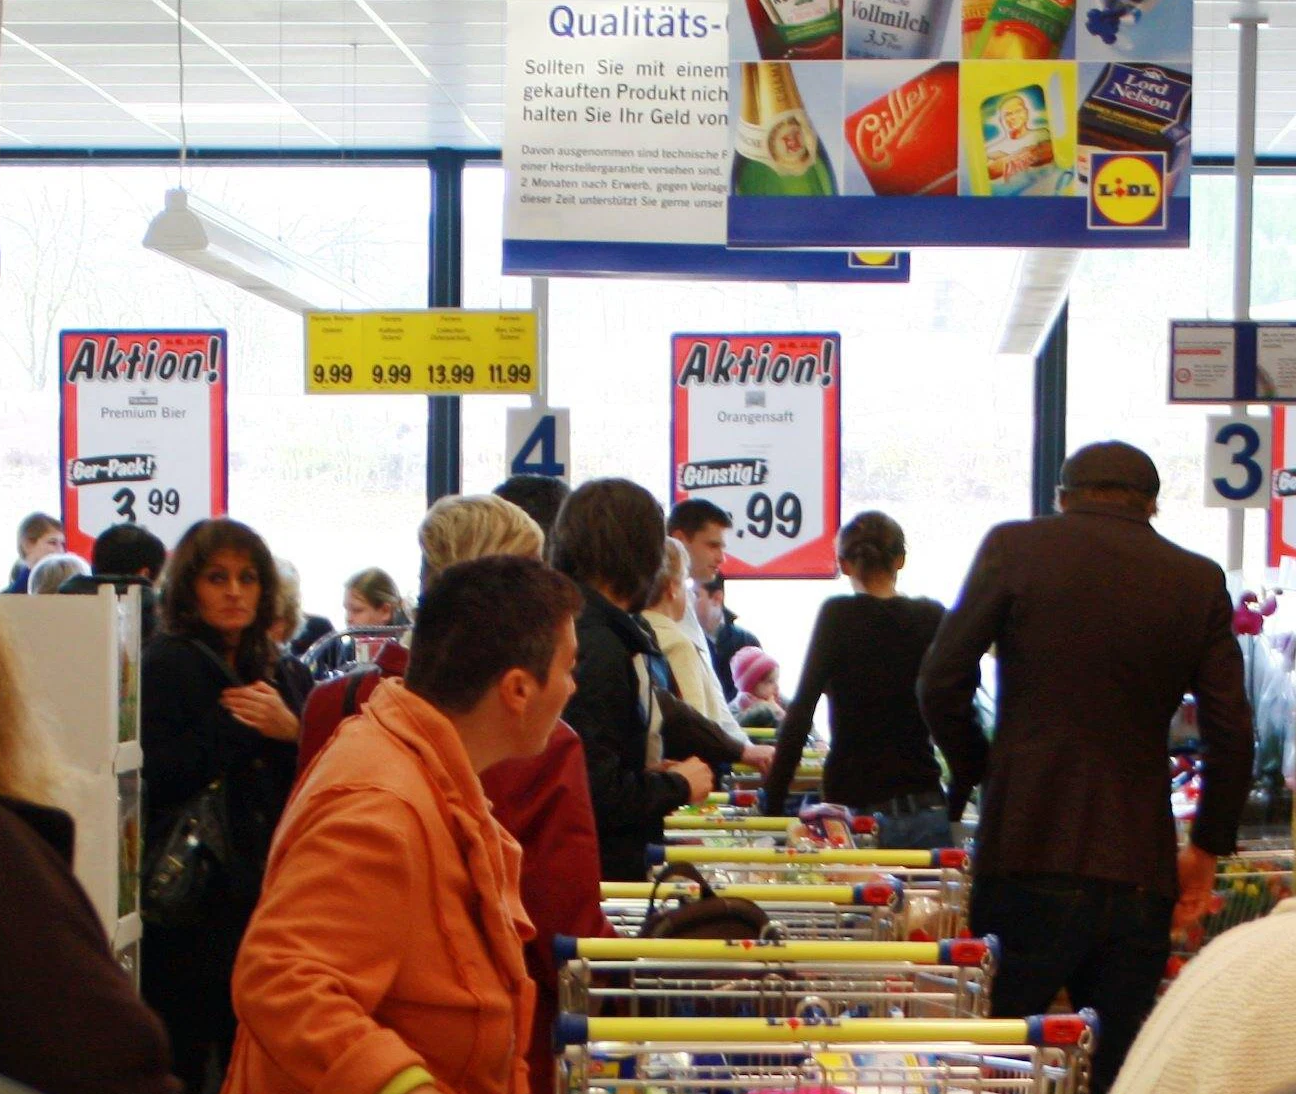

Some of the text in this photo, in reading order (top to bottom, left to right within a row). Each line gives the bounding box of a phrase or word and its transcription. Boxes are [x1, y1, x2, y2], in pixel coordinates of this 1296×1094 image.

[549, 4, 729, 38] Qualitäts-
[524, 59, 728, 78] Sollten Sie mit einem
[523, 83, 728, 102] gekauften Produkt nich
[1124, 73, 1170, 96] Lord
[1112, 82, 1172, 111] Nelson
[522, 105, 728, 126] halten Sie Ihr Geld von
[67, 336, 221, 384] Aktion!
[678, 339, 835, 388] Aktion!
[313, 363, 353, 385] 9.99
[372, 363, 412, 385] 9.99
[427, 363, 475, 385] 13.99
[488, 363, 532, 385] 11.99
[100, 406, 187, 419] Premium Bier
[716, 410, 794, 425] Orangensaft
[511, 415, 565, 476] 4
[1212, 422, 1263, 501] 3
[683, 460, 762, 486] Günstig!
